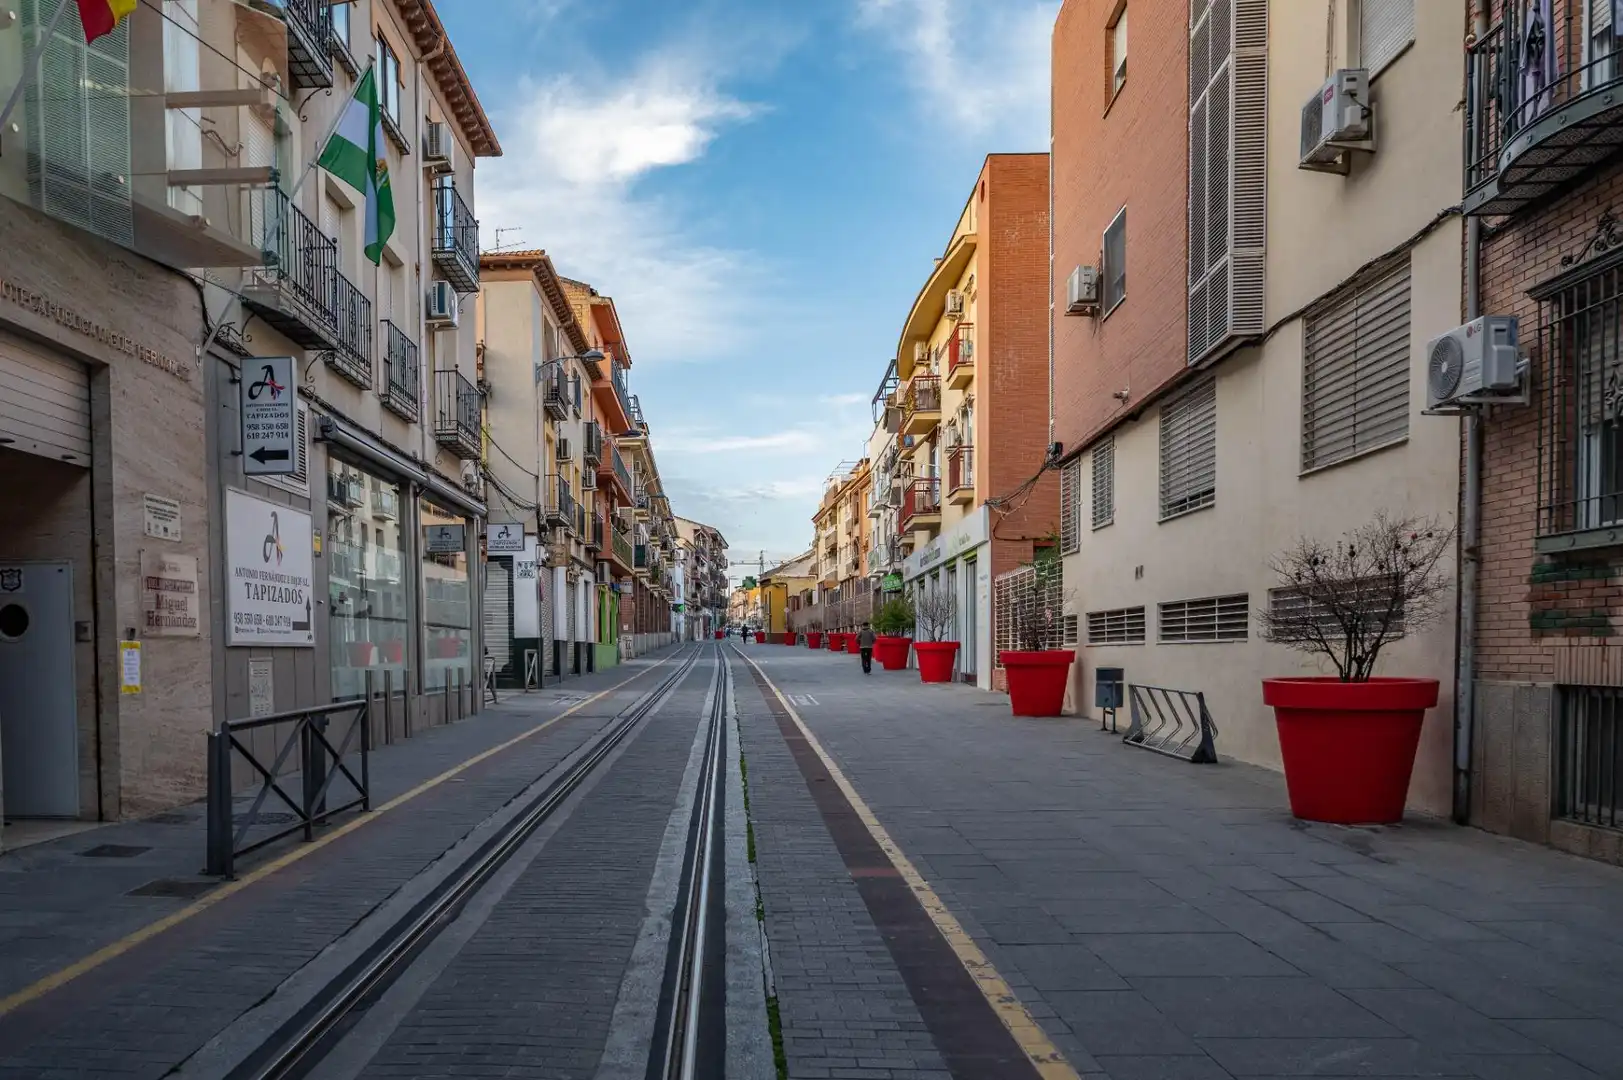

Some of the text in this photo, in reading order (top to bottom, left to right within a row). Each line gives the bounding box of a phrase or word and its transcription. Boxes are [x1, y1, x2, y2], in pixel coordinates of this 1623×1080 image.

[1473, 323, 1482, 333] LG
[246, 423, 260, 431] 958
[275, 422, 289, 430] 658
[246, 431, 289, 440] 618 247 914
[244, 582, 303, 605] TAPIZADOS
[234, 612, 243, 625] 958
